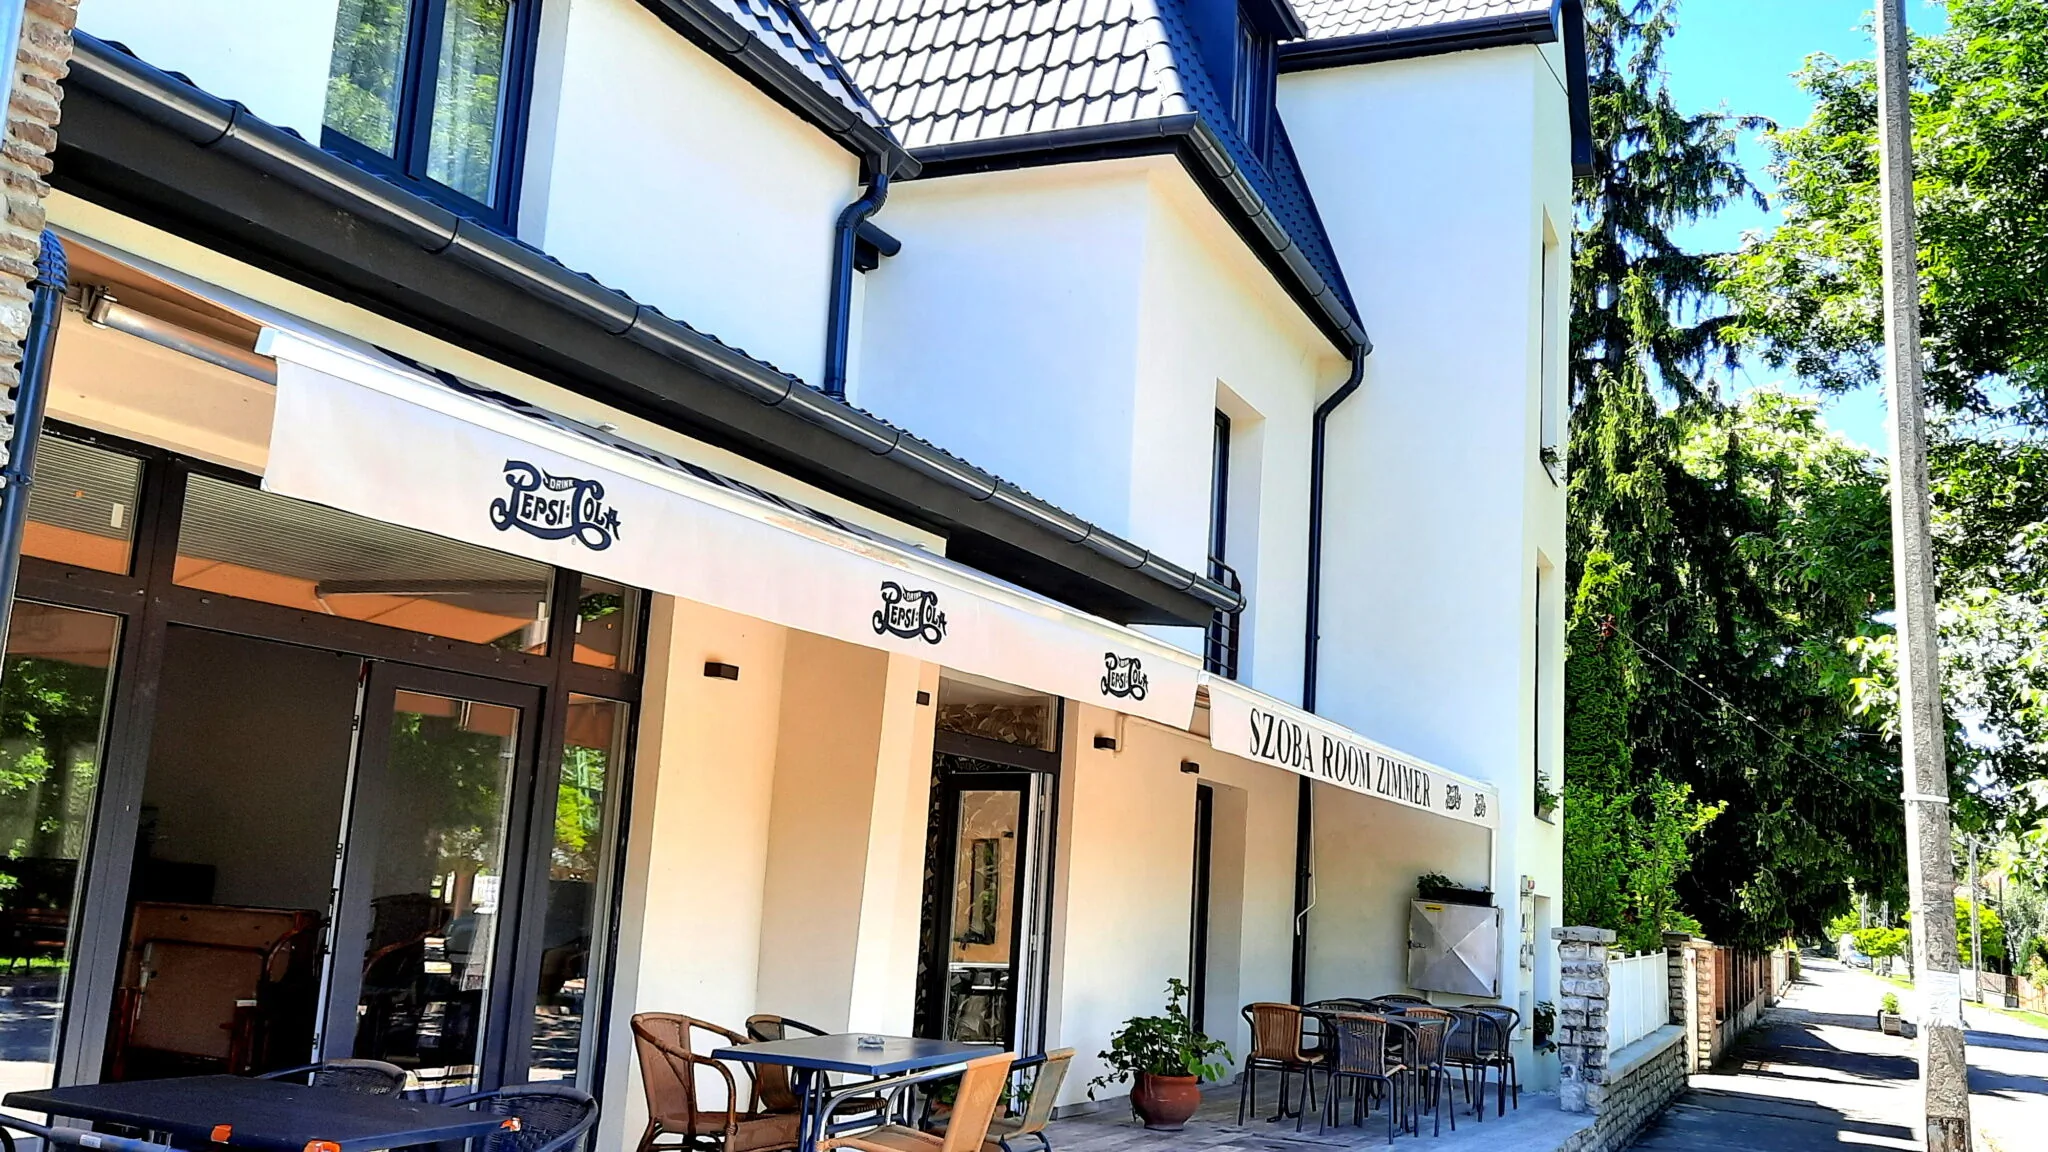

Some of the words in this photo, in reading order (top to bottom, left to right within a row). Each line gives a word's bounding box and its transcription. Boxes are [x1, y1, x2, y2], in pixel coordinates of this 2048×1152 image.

[549, 479, 574, 490] DRINK
[1250, 708, 1314, 773] SZOBA
[1322, 735, 1371, 790] ROOM
[1376, 756, 1431, 808] ZIMMER
